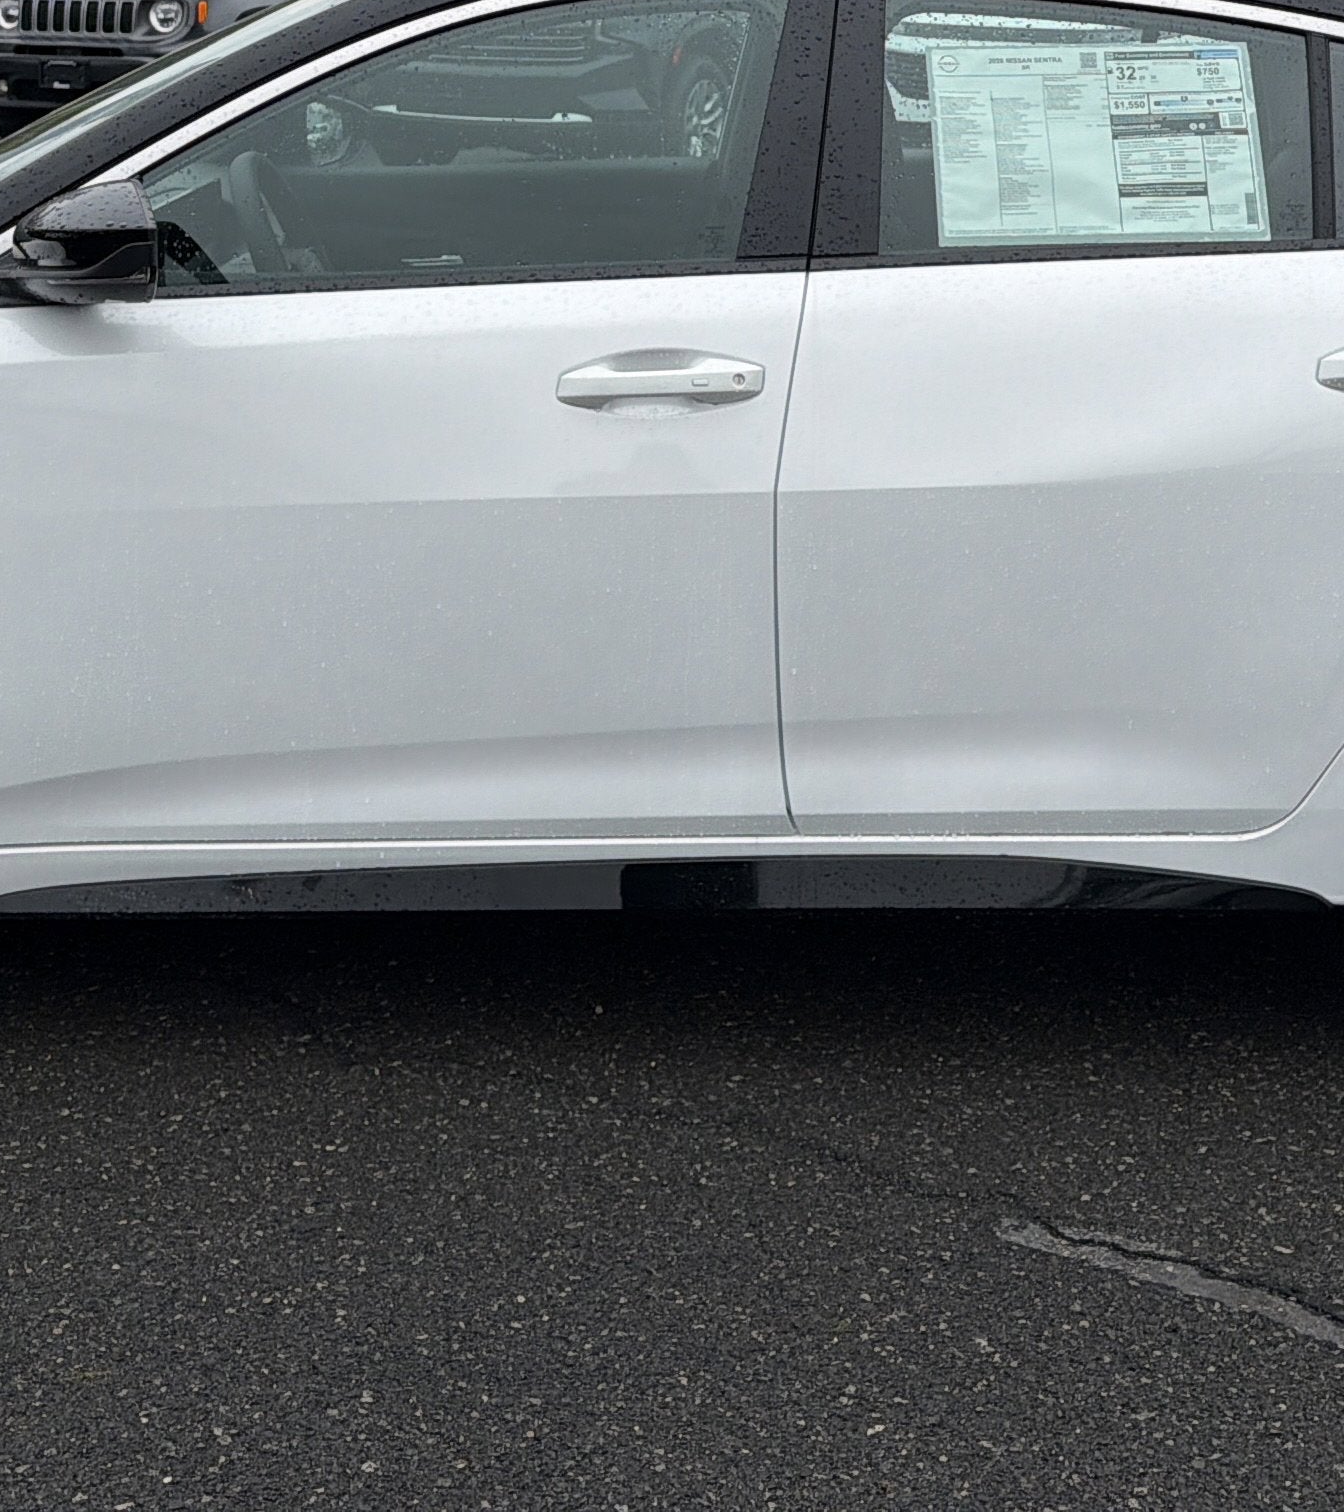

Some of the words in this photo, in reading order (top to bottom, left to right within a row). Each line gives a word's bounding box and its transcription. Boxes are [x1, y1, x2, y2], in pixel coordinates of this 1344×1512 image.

[1116, 65, 1137, 80] 32
[1196, 67, 1220, 76] $750
[1113, 100, 1146, 110] $1,550
